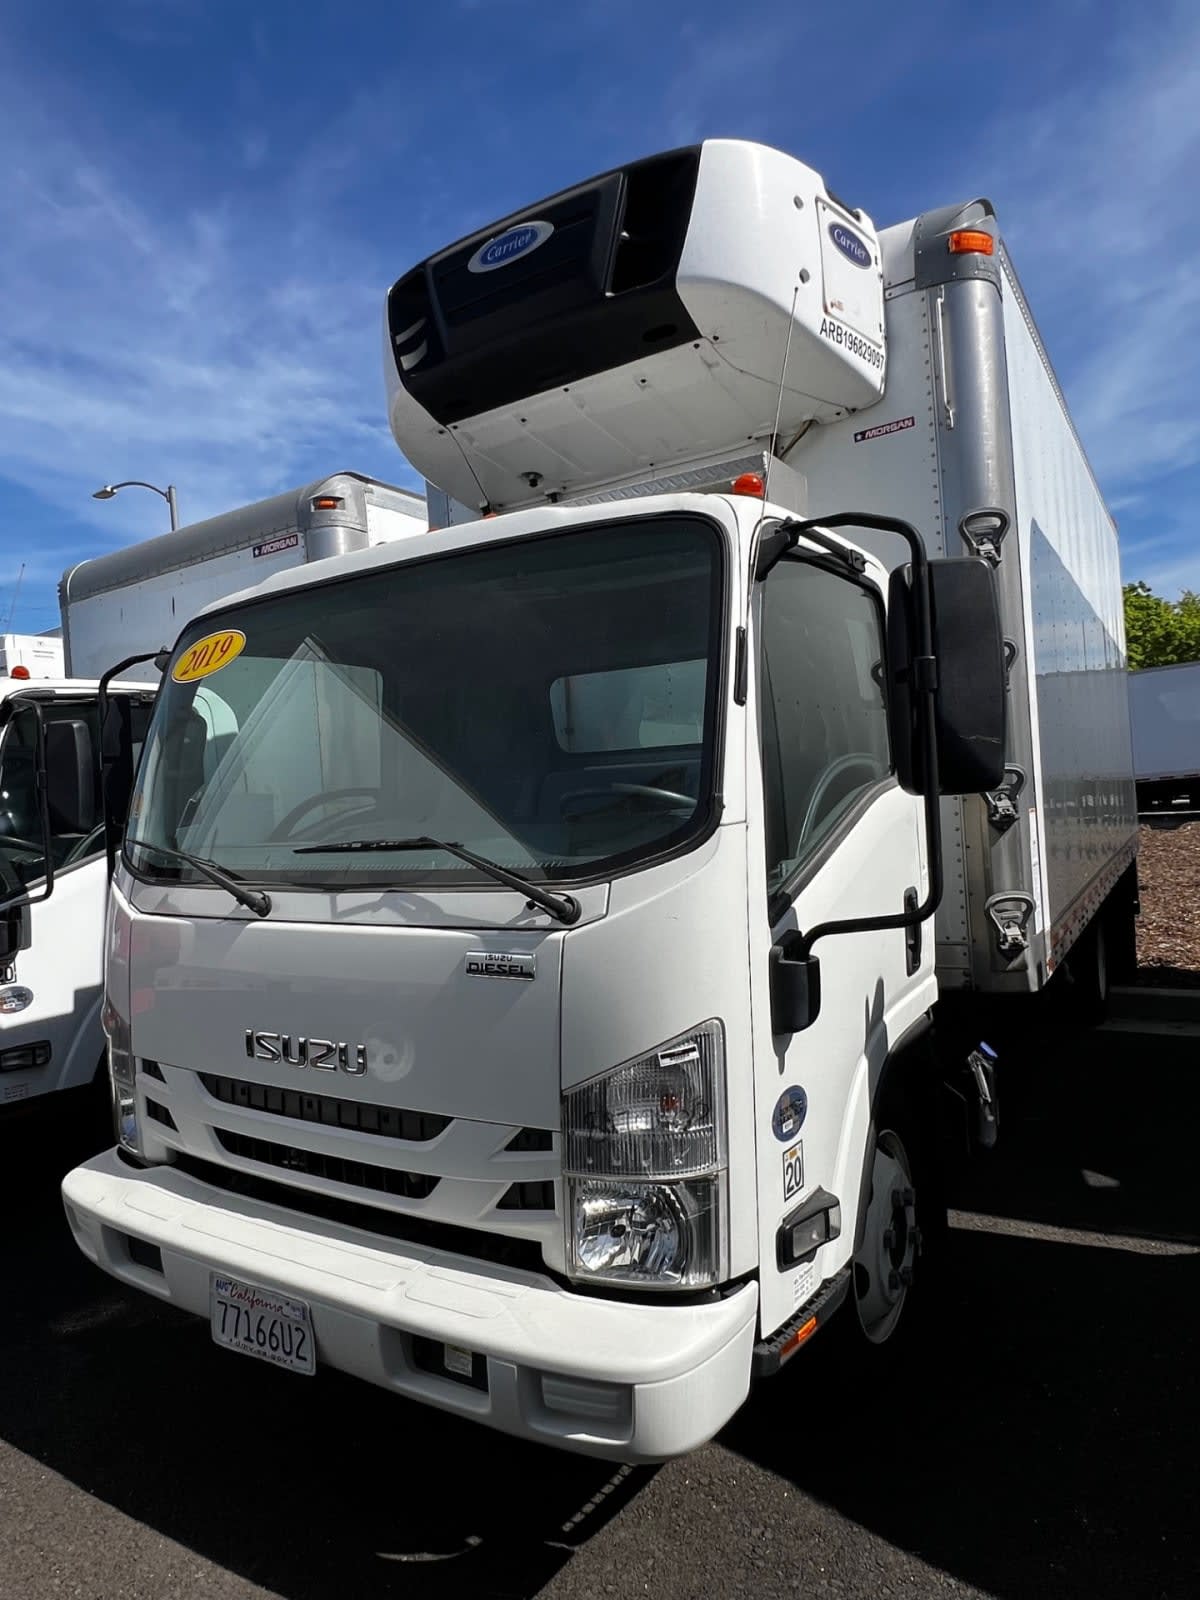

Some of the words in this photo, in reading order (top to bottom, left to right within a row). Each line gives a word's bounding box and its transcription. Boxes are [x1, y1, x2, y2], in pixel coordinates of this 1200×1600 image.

[486, 229, 532, 262] Carrier
[833, 227, 867, 260] Carrier
[819, 317, 885, 371] ARB196829097
[864, 418, 914, 440] MORGAN
[260, 535, 298, 556] MORGAN
[180, 634, 234, 677] 2019
[466, 961, 534, 977] DIESEL
[485, 953, 513, 962] ISUZU
[245, 1028, 368, 1077] ISUZU
[785, 1156, 802, 1195] 20
[230, 1283, 290, 1318] California
[216, 1300, 308, 1362] 77166U2
